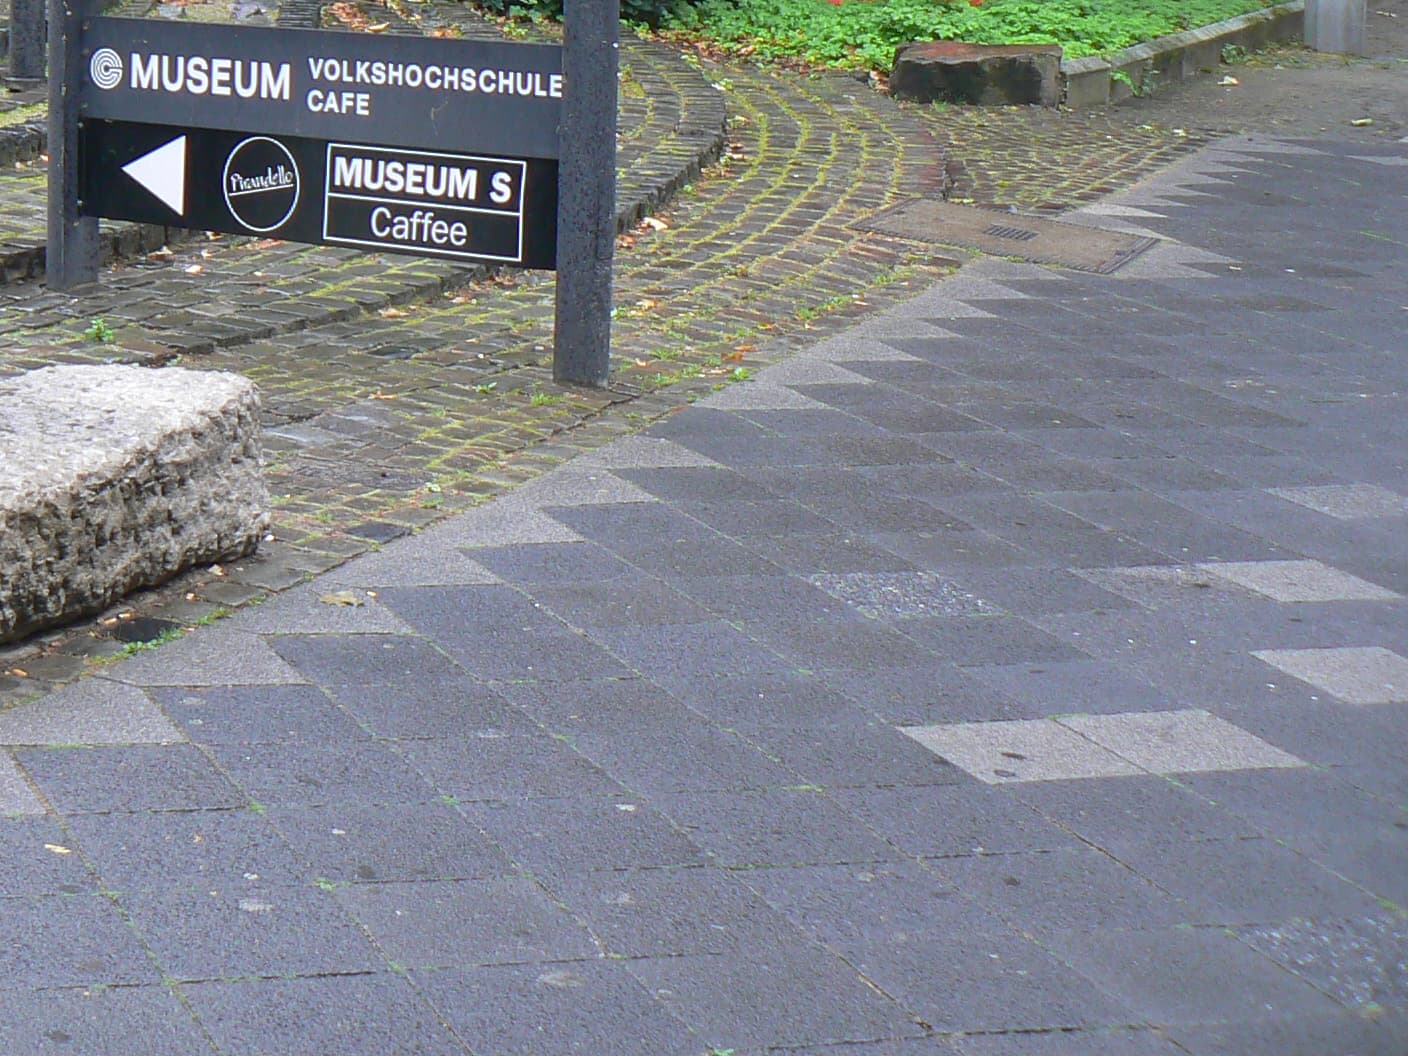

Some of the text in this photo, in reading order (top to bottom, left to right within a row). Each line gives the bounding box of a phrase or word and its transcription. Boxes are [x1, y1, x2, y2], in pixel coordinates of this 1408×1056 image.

[130, 53, 291, 100] MUSEUM
[308, 57, 563, 98] VOLKSHOCHSCHULE
[307, 90, 370, 116] CAFE
[230, 165, 294, 192] Pirandello
[334, 156, 512, 203] MUSEUM S
[370, 207, 469, 246] Caffee
